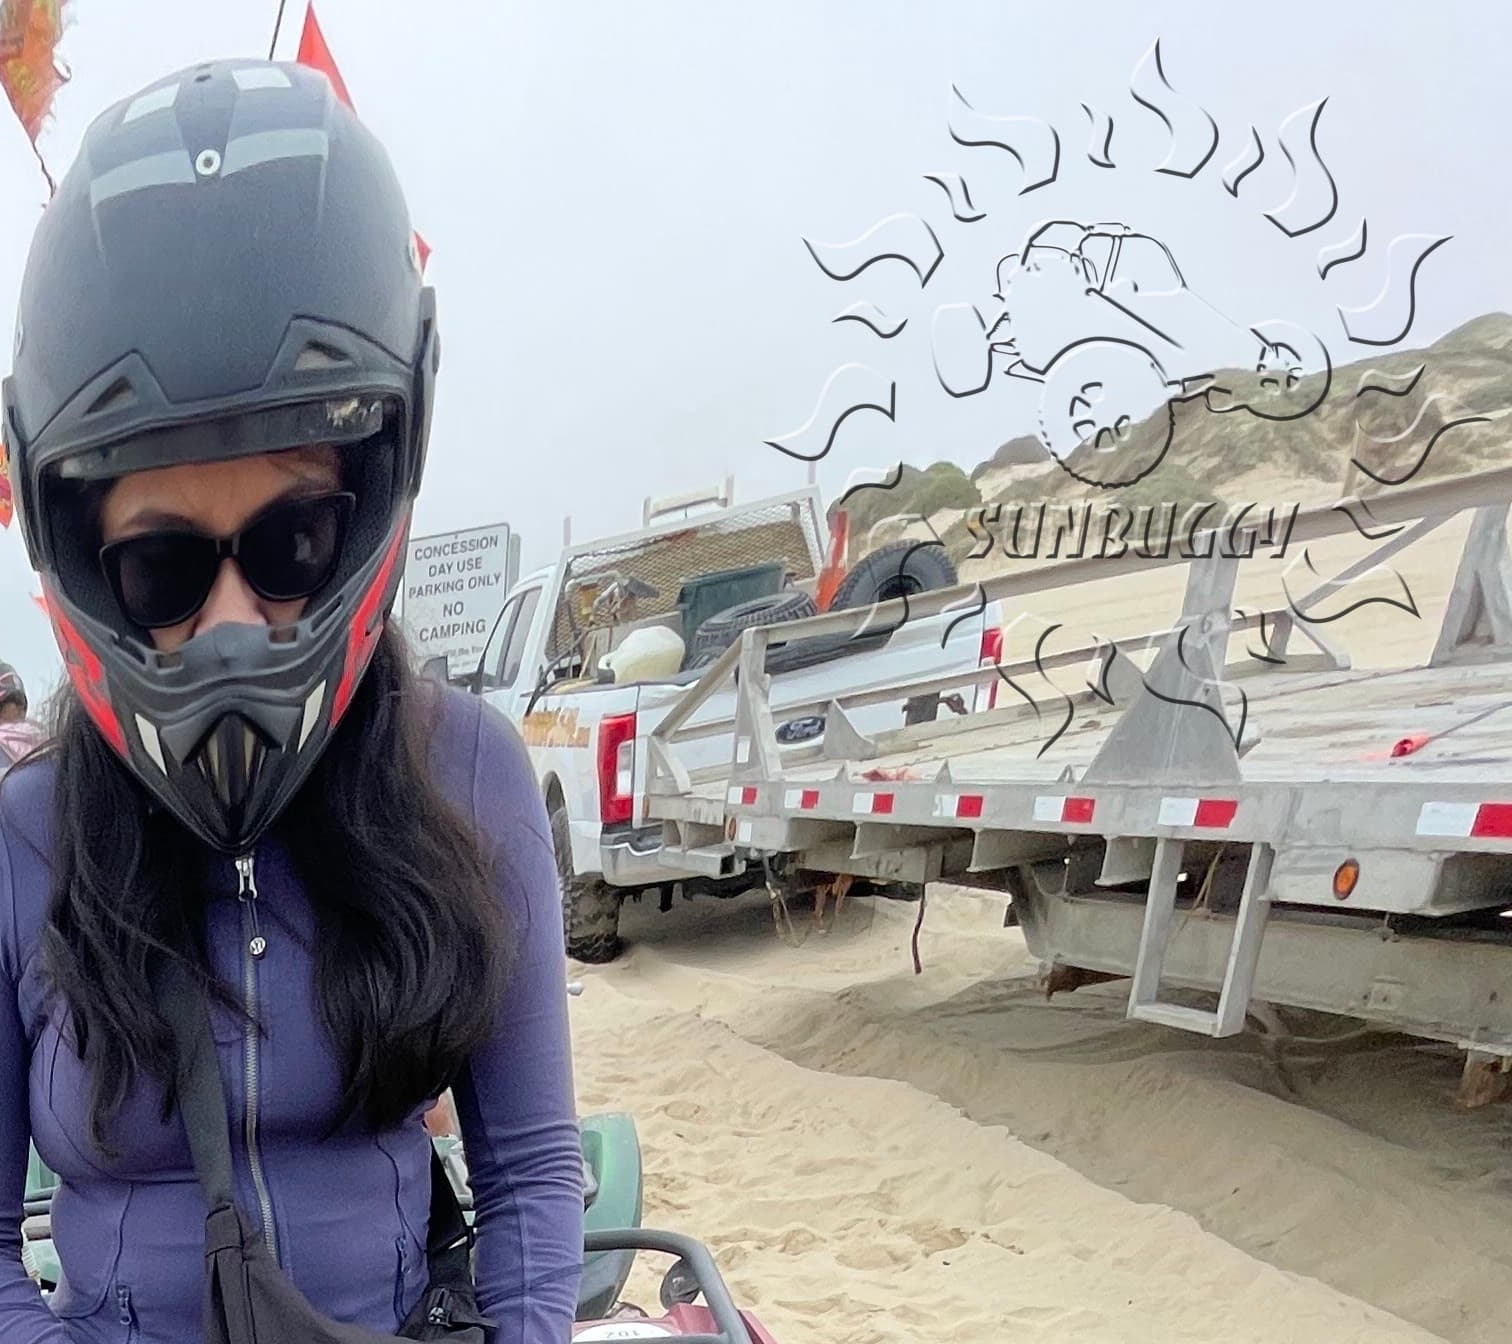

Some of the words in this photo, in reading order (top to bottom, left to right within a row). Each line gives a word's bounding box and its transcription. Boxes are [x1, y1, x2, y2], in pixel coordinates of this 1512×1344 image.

[414, 535, 499, 561] CONCESSION
[428, 561, 453, 577] DAY
[456, 557, 483, 573] USE
[408, 579, 464, 599] PARKING
[468, 573, 501, 588] ONLY
[442, 601, 464, 617] NO
[419, 619, 487, 642] CAMPING
[783, 718, 823, 741] Ford
